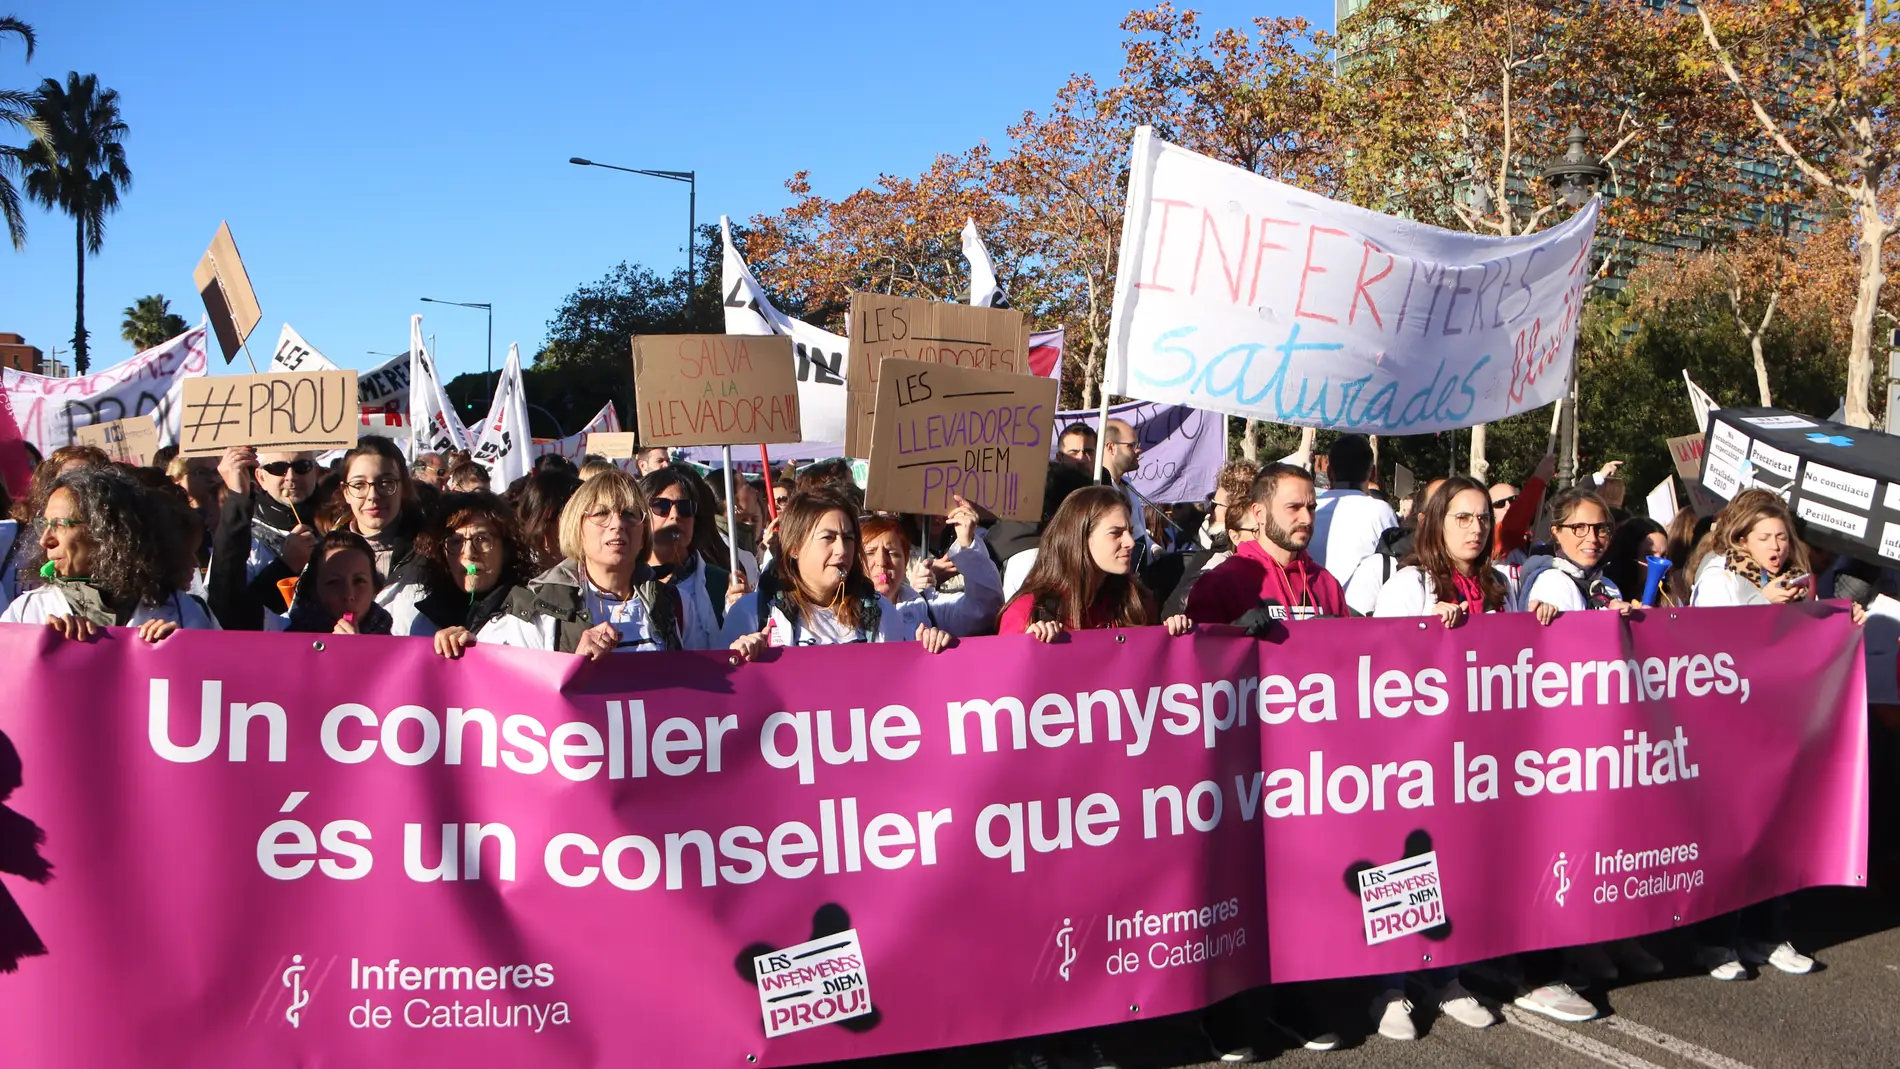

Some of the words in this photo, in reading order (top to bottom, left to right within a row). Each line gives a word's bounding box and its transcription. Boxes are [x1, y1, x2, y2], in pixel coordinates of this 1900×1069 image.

[1134, 198, 1546, 338] INFERMERES
[864, 307, 907, 344] LES
[274, 339, 310, 371] LES
[679, 338, 753, 378] SALVA
[703, 380, 714, 397] A
[722, 379, 739, 397] LA
[896, 371, 932, 407] LES
[184, 376, 346, 443] #PROU
[648, 394, 799, 437] LLEVADORA!!!
[898, 405, 1043, 455] LLEVADORES
[964, 446, 1010, 474] DIEM
[1752, 449, 1793, 473] Precarietat
[922, 465, 1019, 517] PROU!!!
[1713, 477, 1728, 492] 2010
[1804, 471, 1818, 483] No
[1819, 477, 1870, 499] conciliació
[1805, 507, 1857, 531] Perillositat
[149, 678, 288, 763] Un
[320, 699, 739, 782] conseller
[760, 705, 922, 785] que
[947, 673, 1337, 757] menysprea
[1358, 655, 1450, 718] les
[1466, 647, 1751, 713] infermeres,
[256, 791, 374, 881] és
[403, 822, 517, 883] un
[543, 797, 953, 892] conseller
[974, 792, 1121, 874] que
[1142, 779, 1223, 840] no
[1234, 750, 1435, 820] valora
[1453, 741, 1499, 803] la
[1513, 725, 1700, 797] sanitat.
[1595, 842, 1698, 875] Infermeres
[1362, 870, 1387, 887] LES
[1363, 872, 1438, 903] INFERMERES
[1409, 886, 1438, 906] DIEM
[1593, 881, 1618, 904] de
[1624, 869, 1704, 899] Catalunya
[1107, 897, 1239, 942] Infermeres
[1370, 901, 1442, 939] PROU!
[758, 953, 791, 975] LES
[1106, 948, 1139, 975] de
[1148, 927, 1246, 969] Catalunya
[351, 957, 555, 990] Infermeres
[761, 954, 860, 992] INFERMERES
[823, 972, 863, 995] DIEM
[349, 998, 392, 1028] de
[403, 998, 571, 1033] Catalunya
[770, 988, 867, 1031] PROU!
